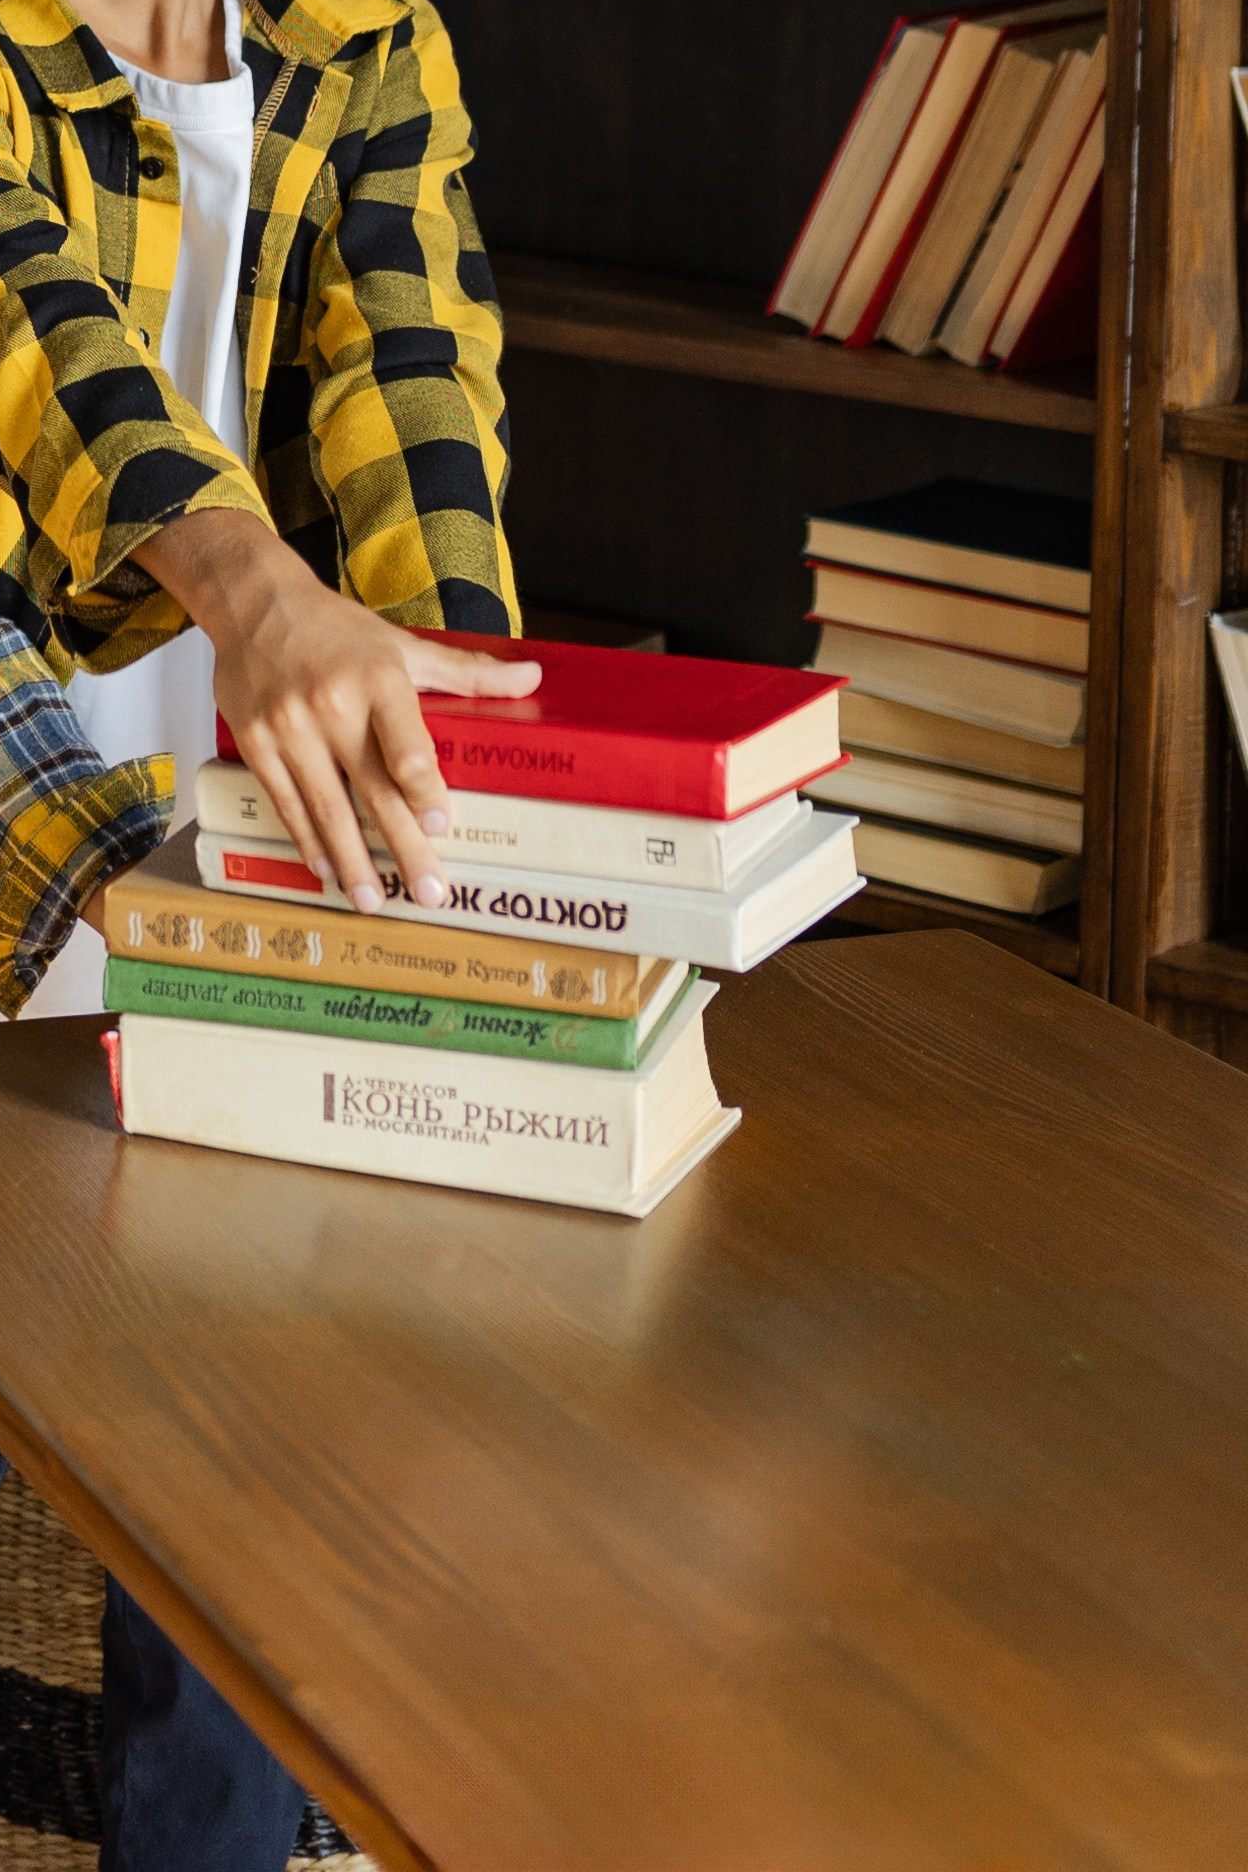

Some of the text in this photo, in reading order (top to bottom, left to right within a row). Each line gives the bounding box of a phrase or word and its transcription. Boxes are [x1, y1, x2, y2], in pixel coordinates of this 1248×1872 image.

[463, 741, 575, 775] НИКОЛАЙ
[488, 890, 628, 935] ДОКТОР
[466, 957, 530, 988] Купер
[141, 978, 306, 1013] ТЕОДОР ДРАЙЗЕР
[341, 1087, 611, 1148] КОНЬ РЫЖИЙ
